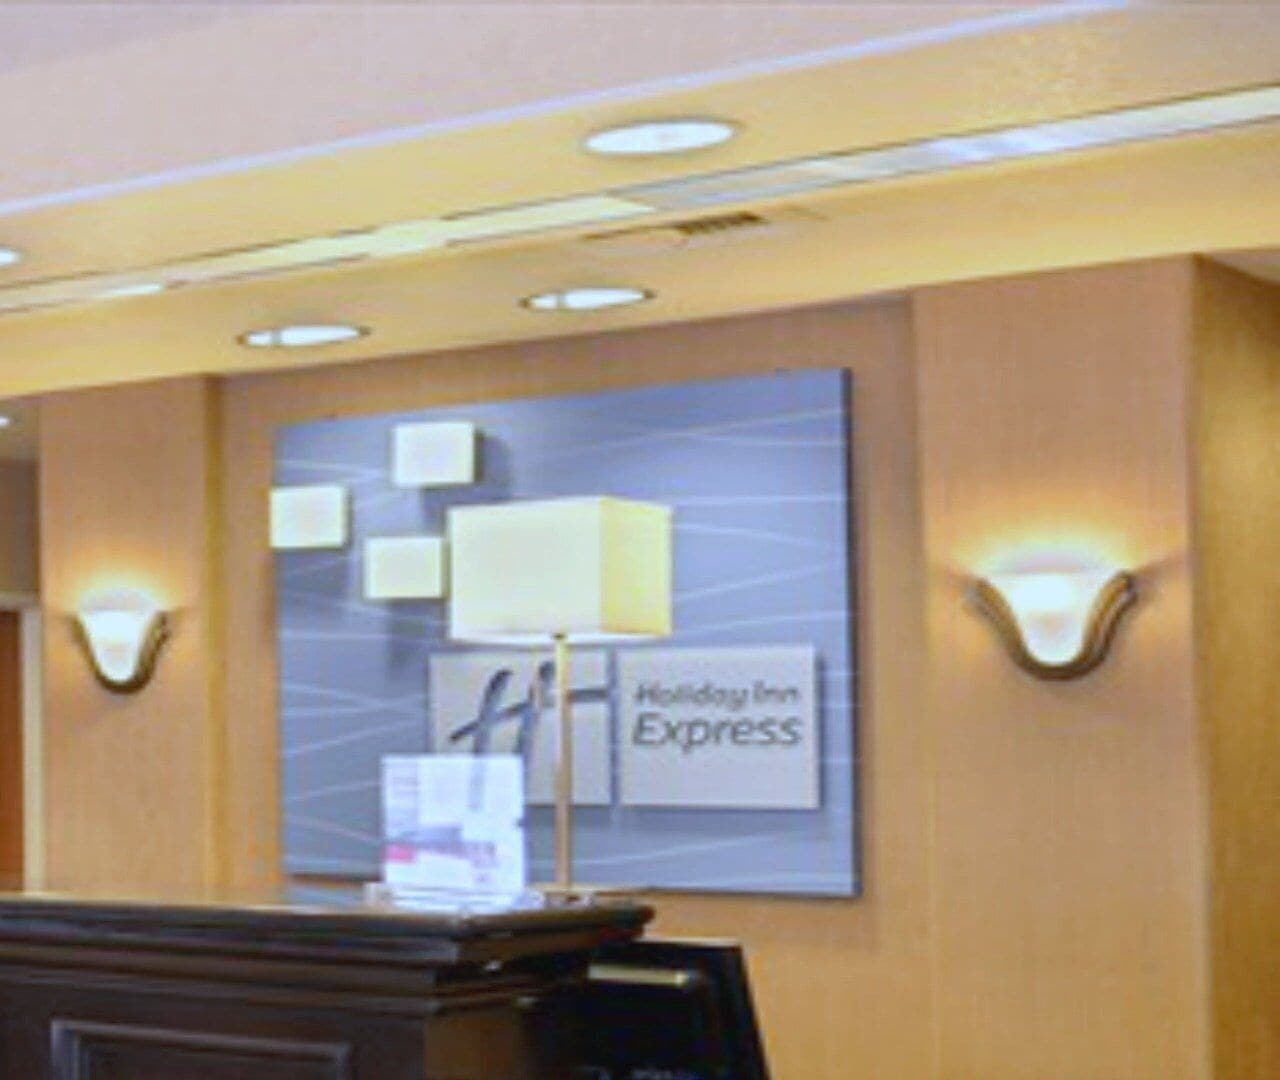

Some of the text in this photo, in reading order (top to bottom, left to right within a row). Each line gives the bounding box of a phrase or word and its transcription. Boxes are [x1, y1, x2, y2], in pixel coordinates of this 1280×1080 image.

[633, 679, 800, 712] Holiday Inn
[632, 710, 803, 755] Express
